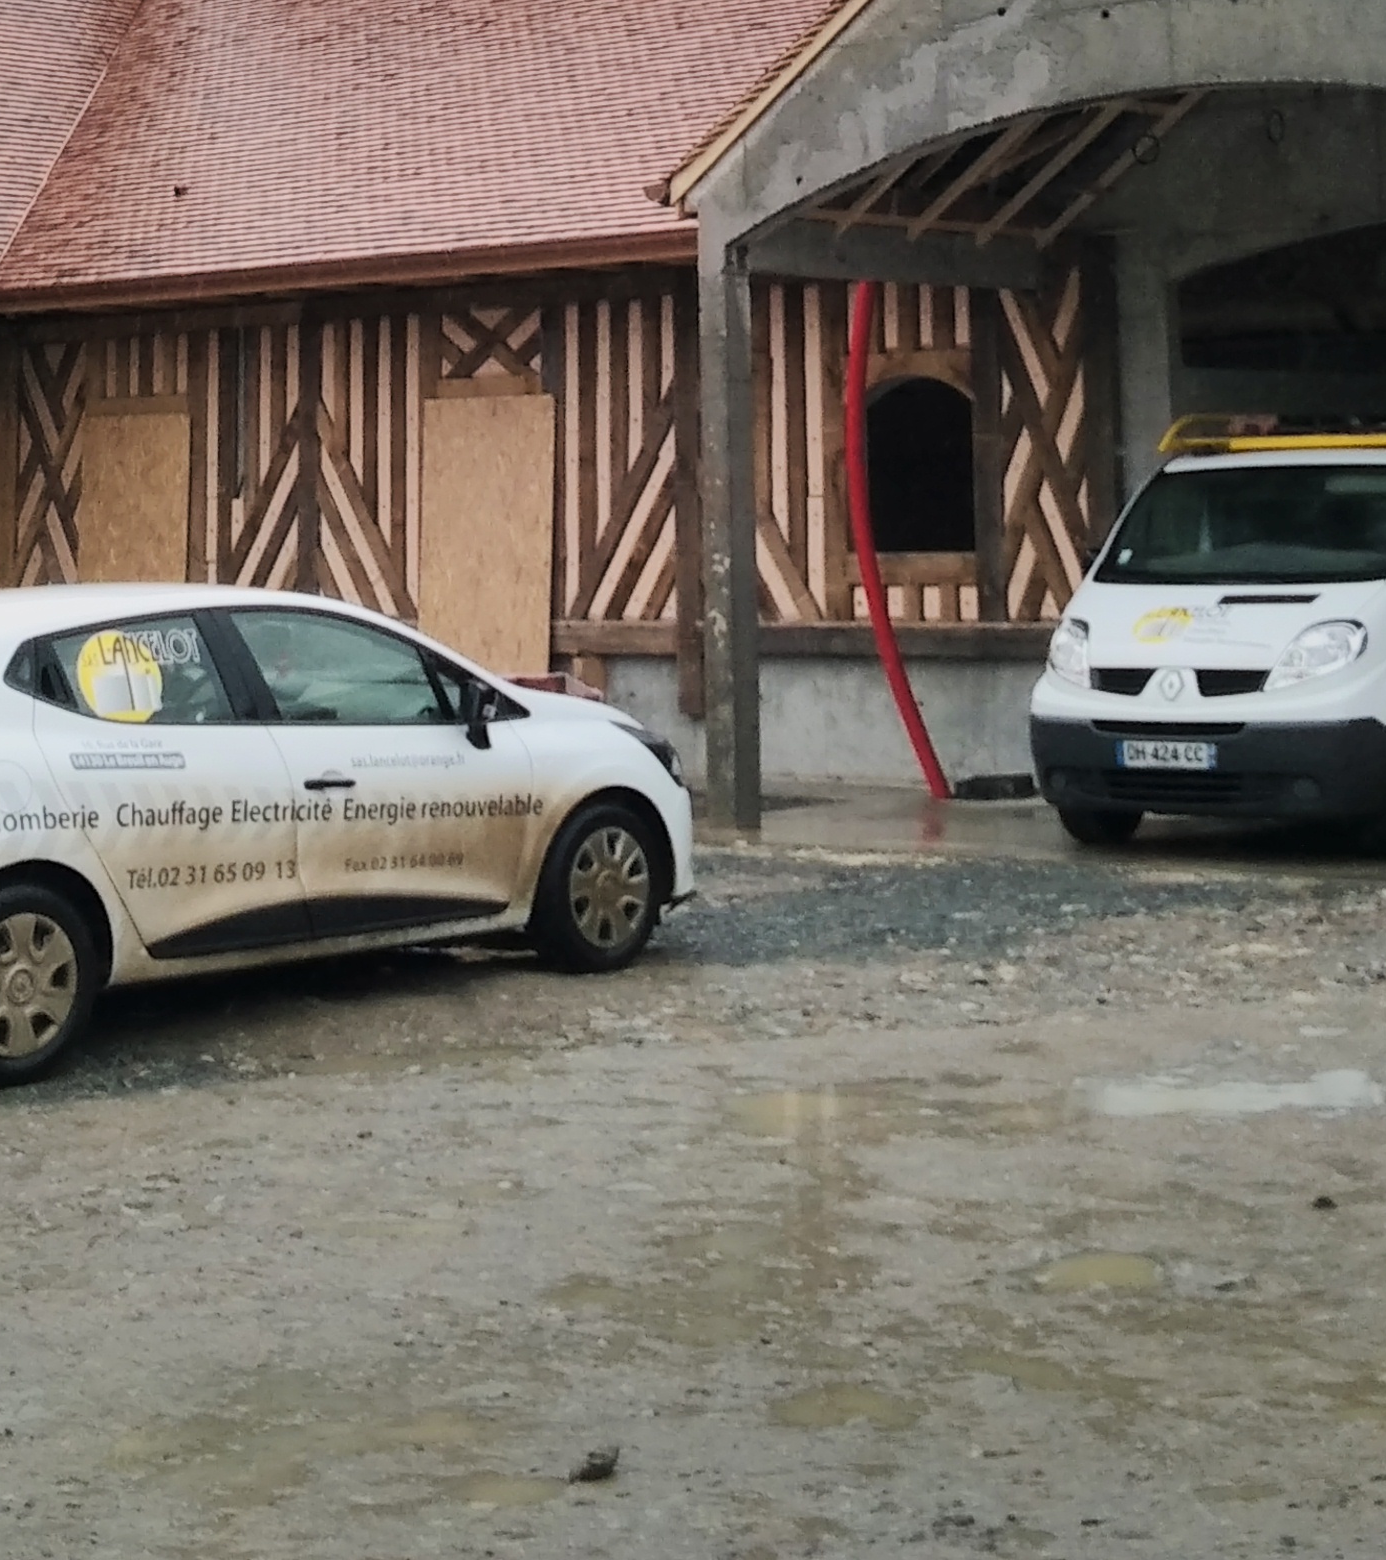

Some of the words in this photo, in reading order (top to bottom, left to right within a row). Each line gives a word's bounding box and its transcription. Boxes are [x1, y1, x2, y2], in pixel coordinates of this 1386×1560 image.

[97, 628, 201, 666] LANCELOT
[116, 800, 223, 830] Chauffage
[231, 798, 333, 823] Electricité
[343, 796, 416, 826] Energie
[421, 793, 544, 818] renouvelable
[185, 865, 207, 885] 31
[214, 862, 237, 883] 65
[242, 861, 266, 881] 09
[276, 859, 296, 879] 13
